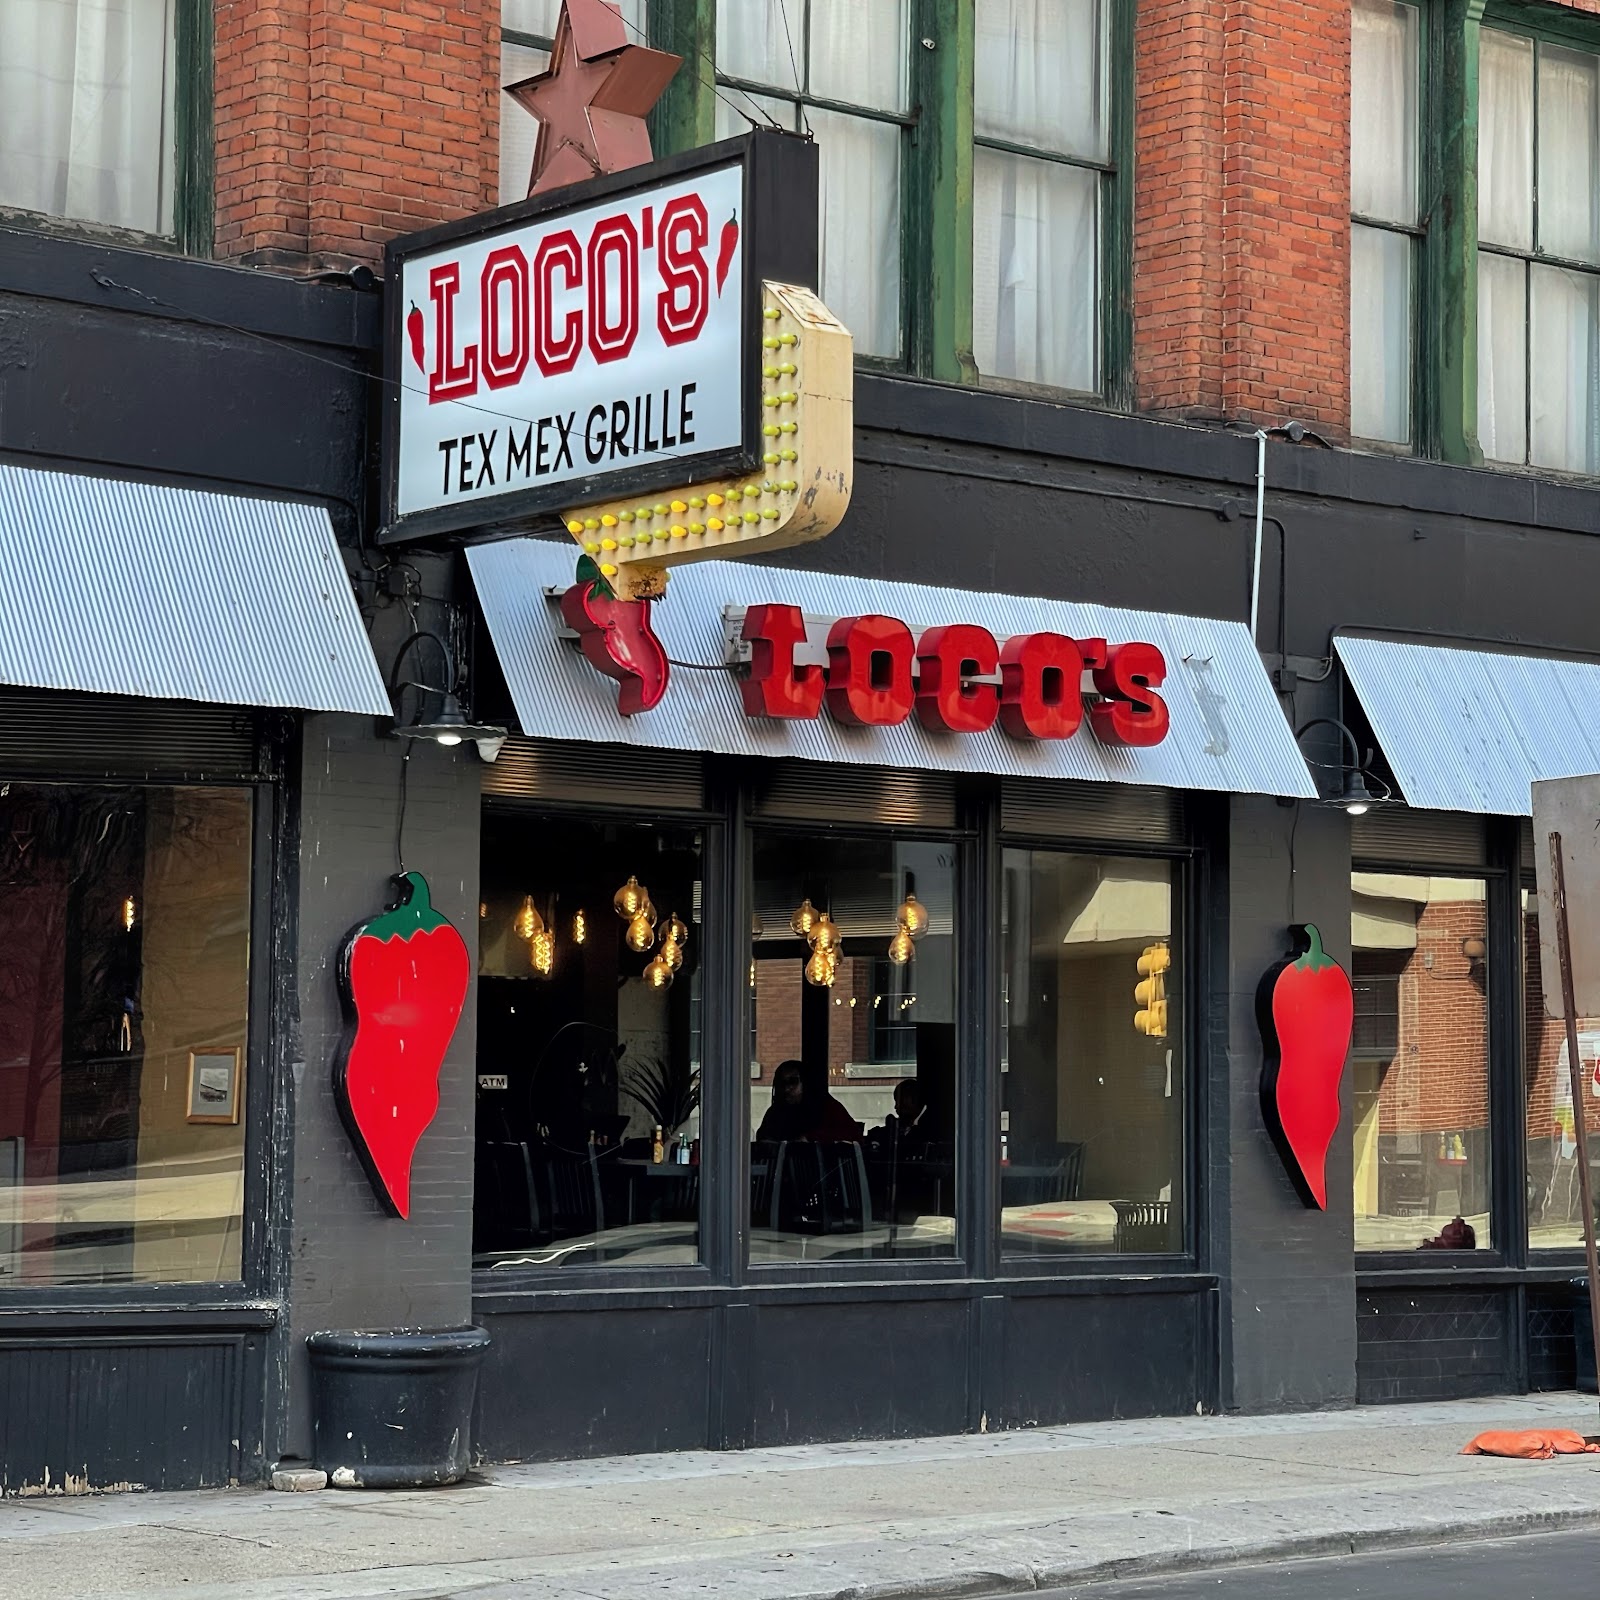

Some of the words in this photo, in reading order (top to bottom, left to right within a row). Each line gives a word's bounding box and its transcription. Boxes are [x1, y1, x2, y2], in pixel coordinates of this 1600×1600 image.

[428, 193, 709, 405] LOCO'S
[438, 429, 499, 495] TEX
[505, 411, 577, 482] MEX
[585, 382, 697, 465] GRILLE
[740, 602, 1170, 748] LOCO'S
[481, 1077, 505, 1086] ATM
